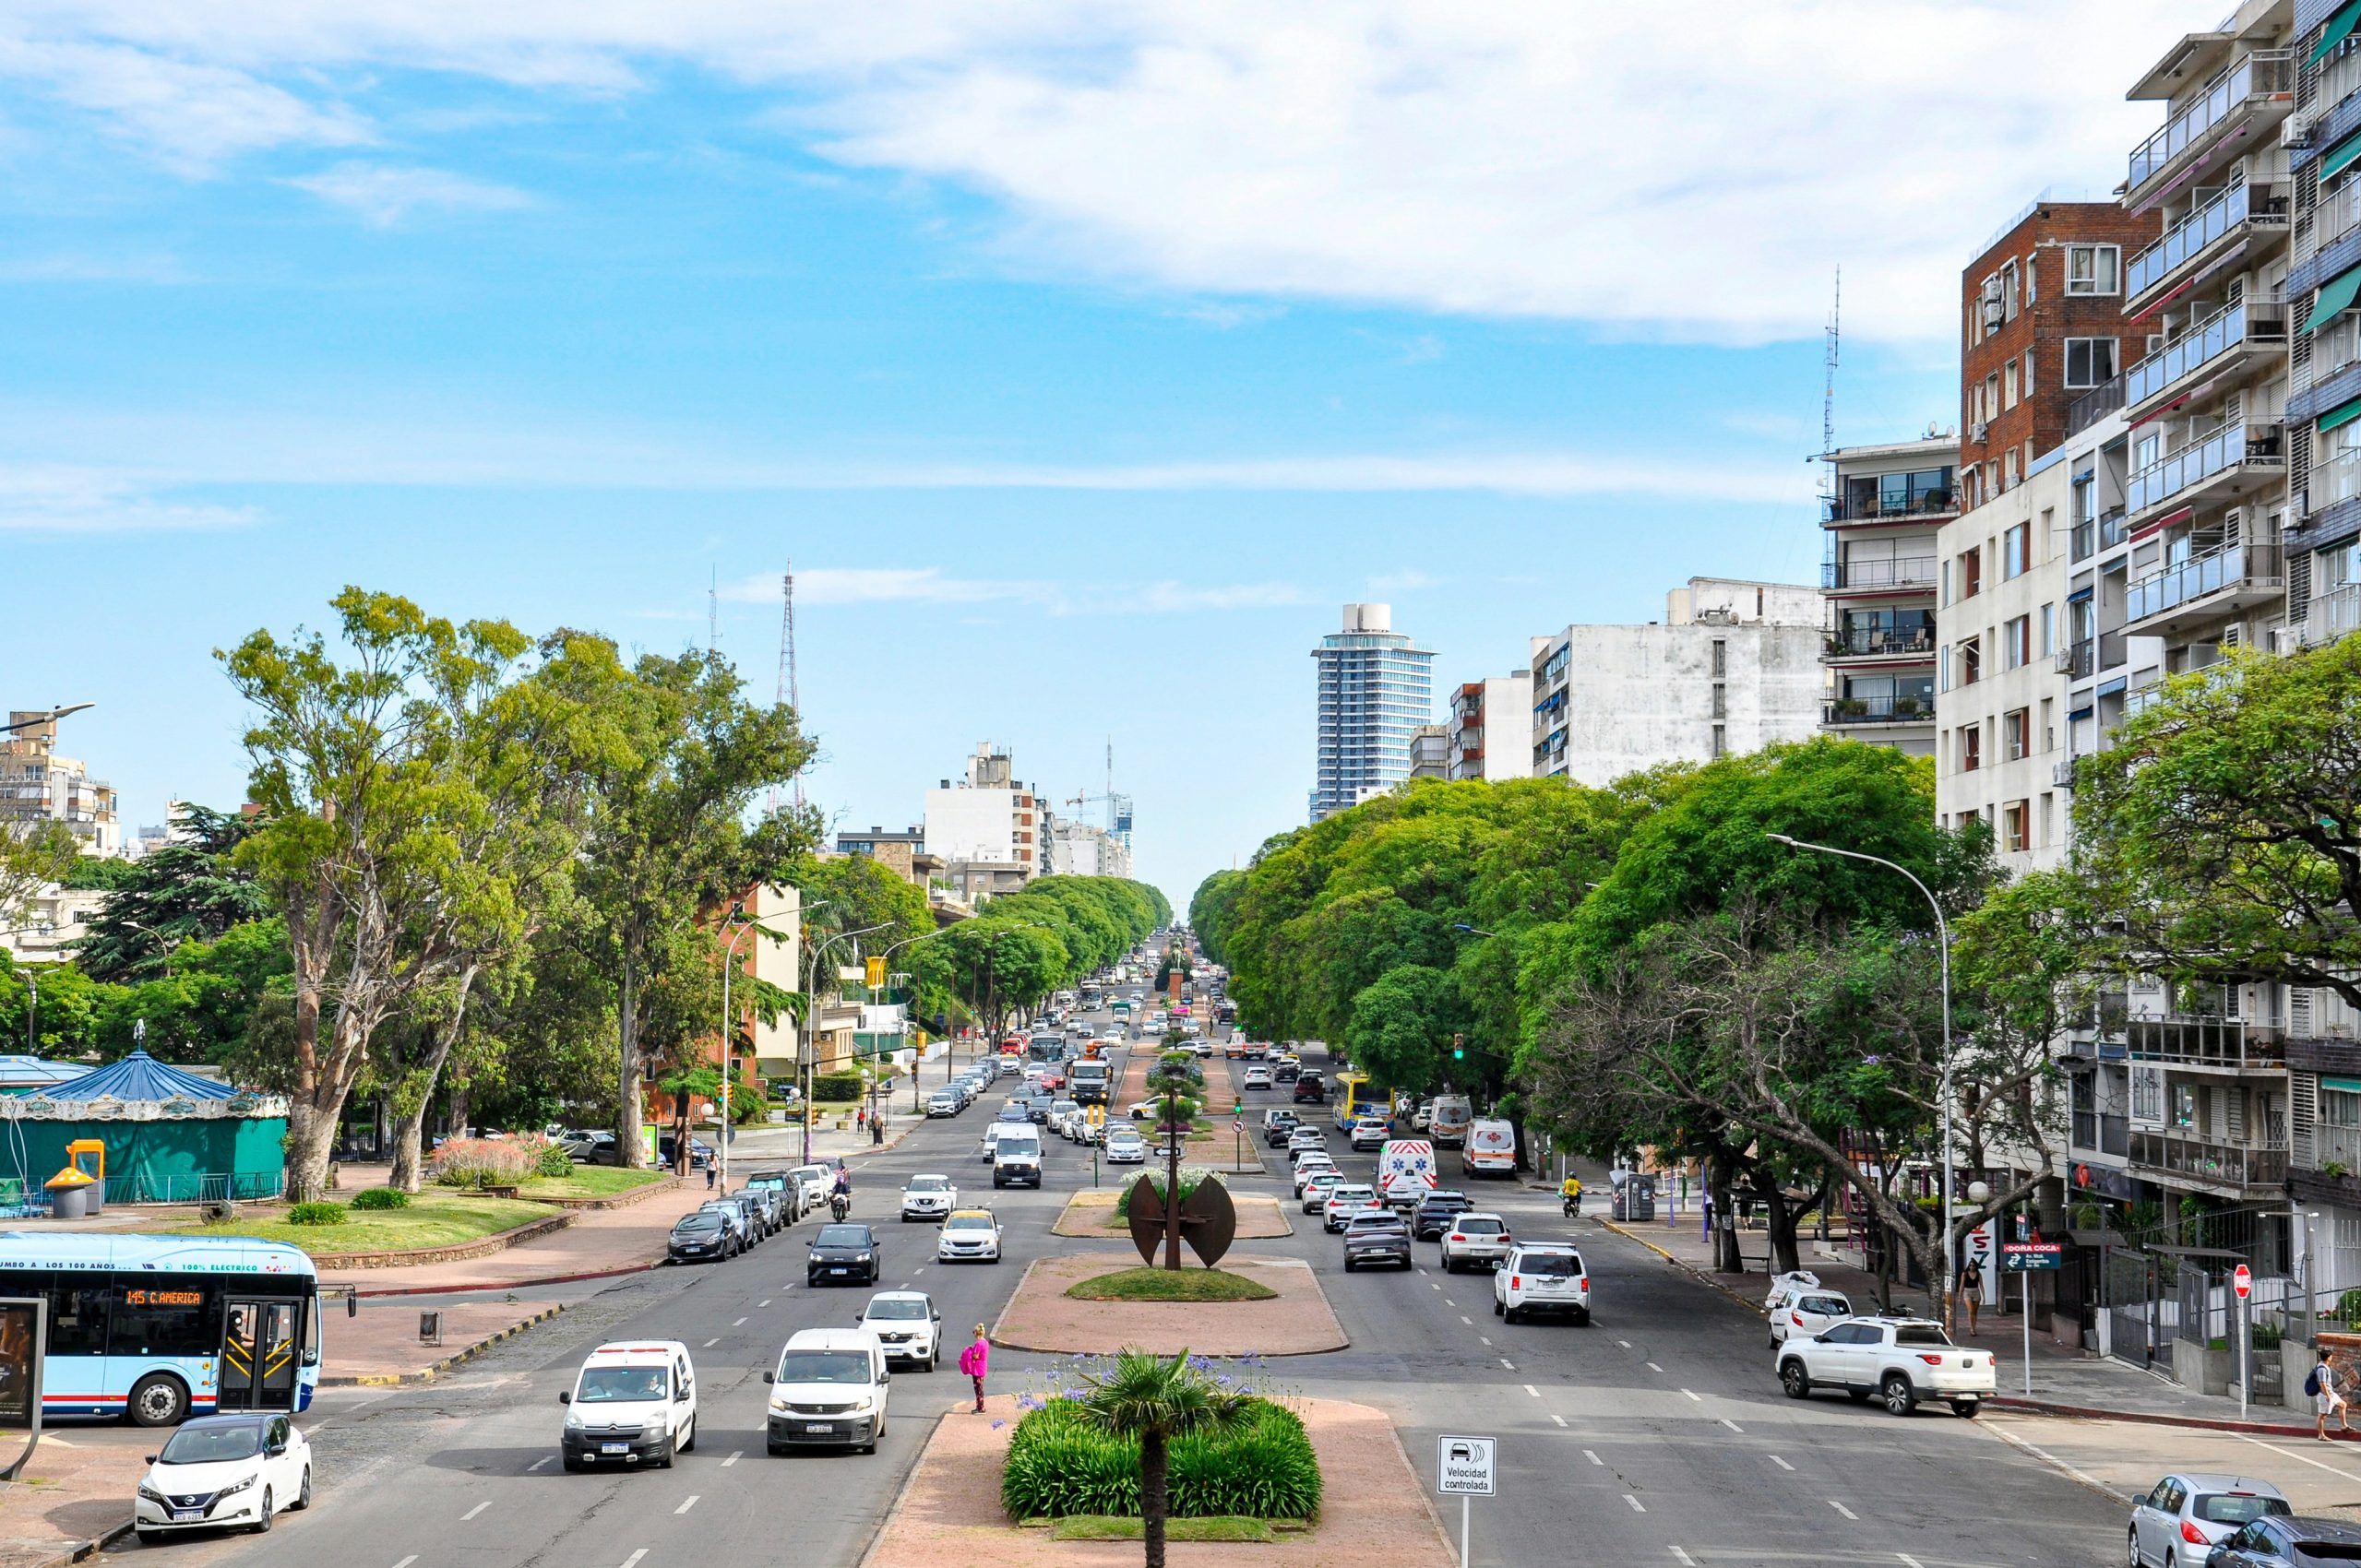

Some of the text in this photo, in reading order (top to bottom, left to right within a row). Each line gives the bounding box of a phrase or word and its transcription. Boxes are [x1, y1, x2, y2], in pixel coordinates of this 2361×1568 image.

[2234, 1275, 2251, 1289] PARE
[127, 1290, 146, 1304] 145
[1447, 1467, 1487, 1479] Velocidad
[1445, 1479, 1488, 1491] controlada
